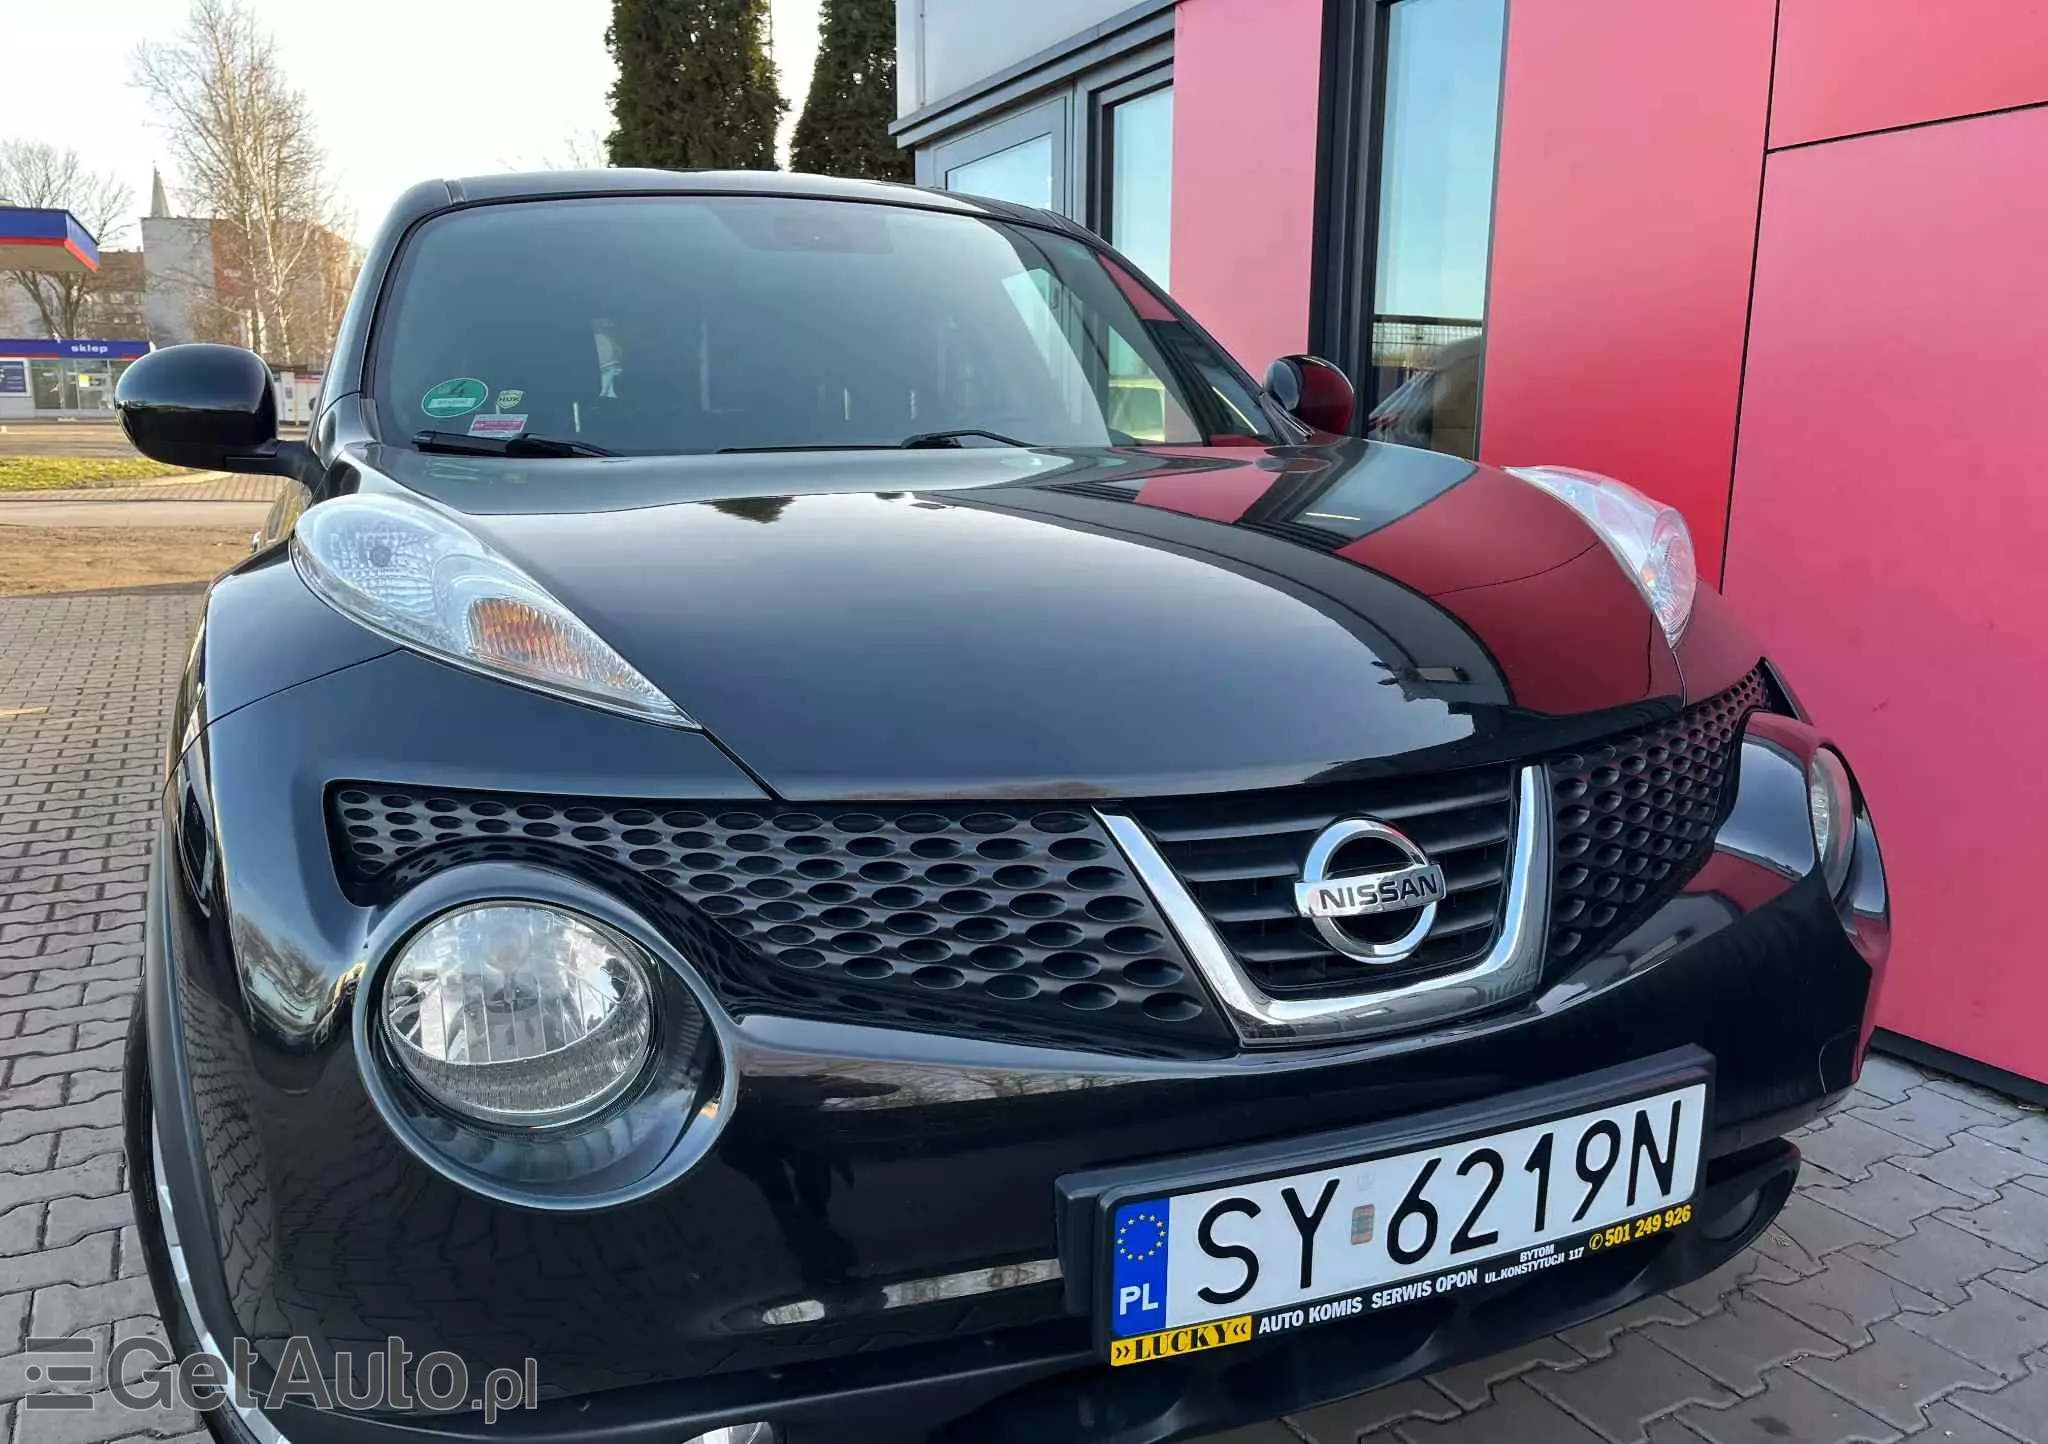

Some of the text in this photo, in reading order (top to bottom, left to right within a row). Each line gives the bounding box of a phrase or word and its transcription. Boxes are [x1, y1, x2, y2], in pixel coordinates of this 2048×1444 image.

[71, 344, 108, 354] sklep
[1319, 873, 1437, 910] NISSAN
[1197, 1099, 1682, 1305] SY 6219N
[1604, 1203, 1692, 1248] 501 249 926
[1519, 1244, 1555, 1263] BYTOM
[1568, 1246, 1585, 1261] 117
[1118, 1282, 1159, 1316] PL
[1258, 1268, 1478, 1335] AUTO KOMIS SERWIS OPON
